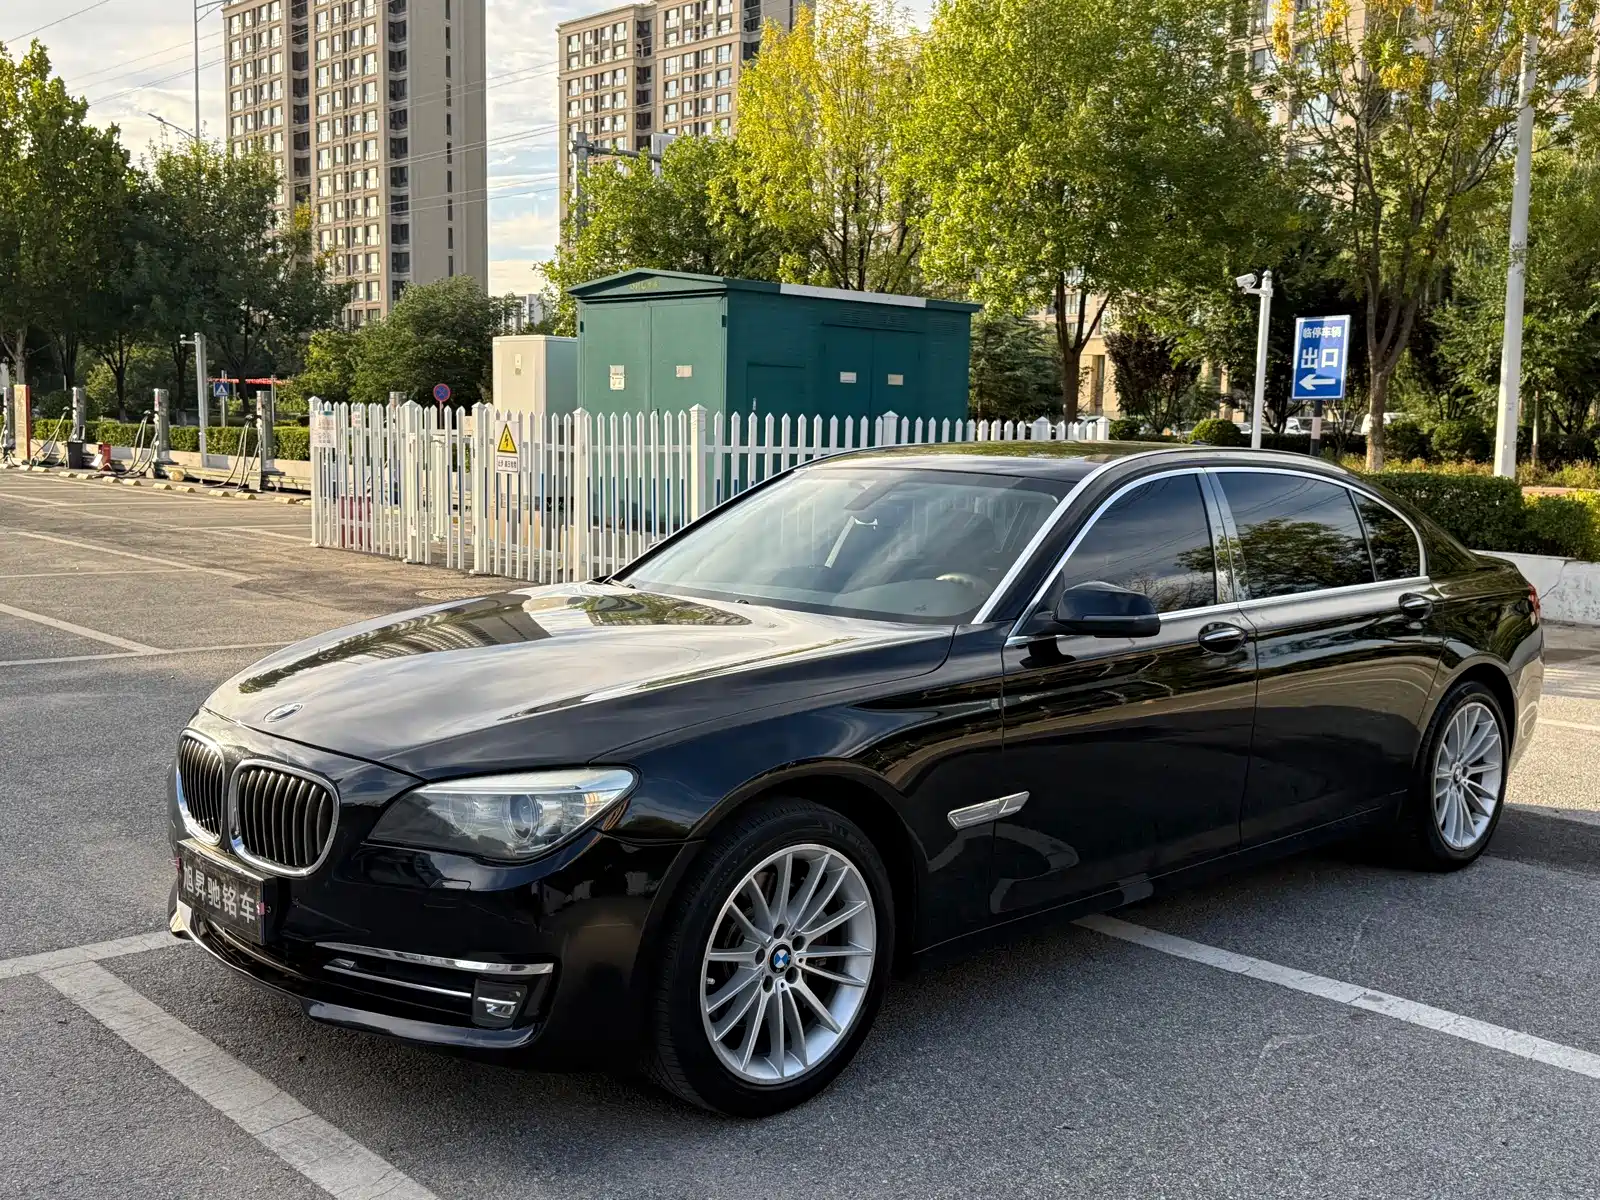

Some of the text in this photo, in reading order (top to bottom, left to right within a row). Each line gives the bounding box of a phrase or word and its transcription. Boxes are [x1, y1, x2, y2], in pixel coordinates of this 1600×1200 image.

[1302, 326, 1342, 338] 临停车辆
[1301, 347, 1339, 368] 出口
